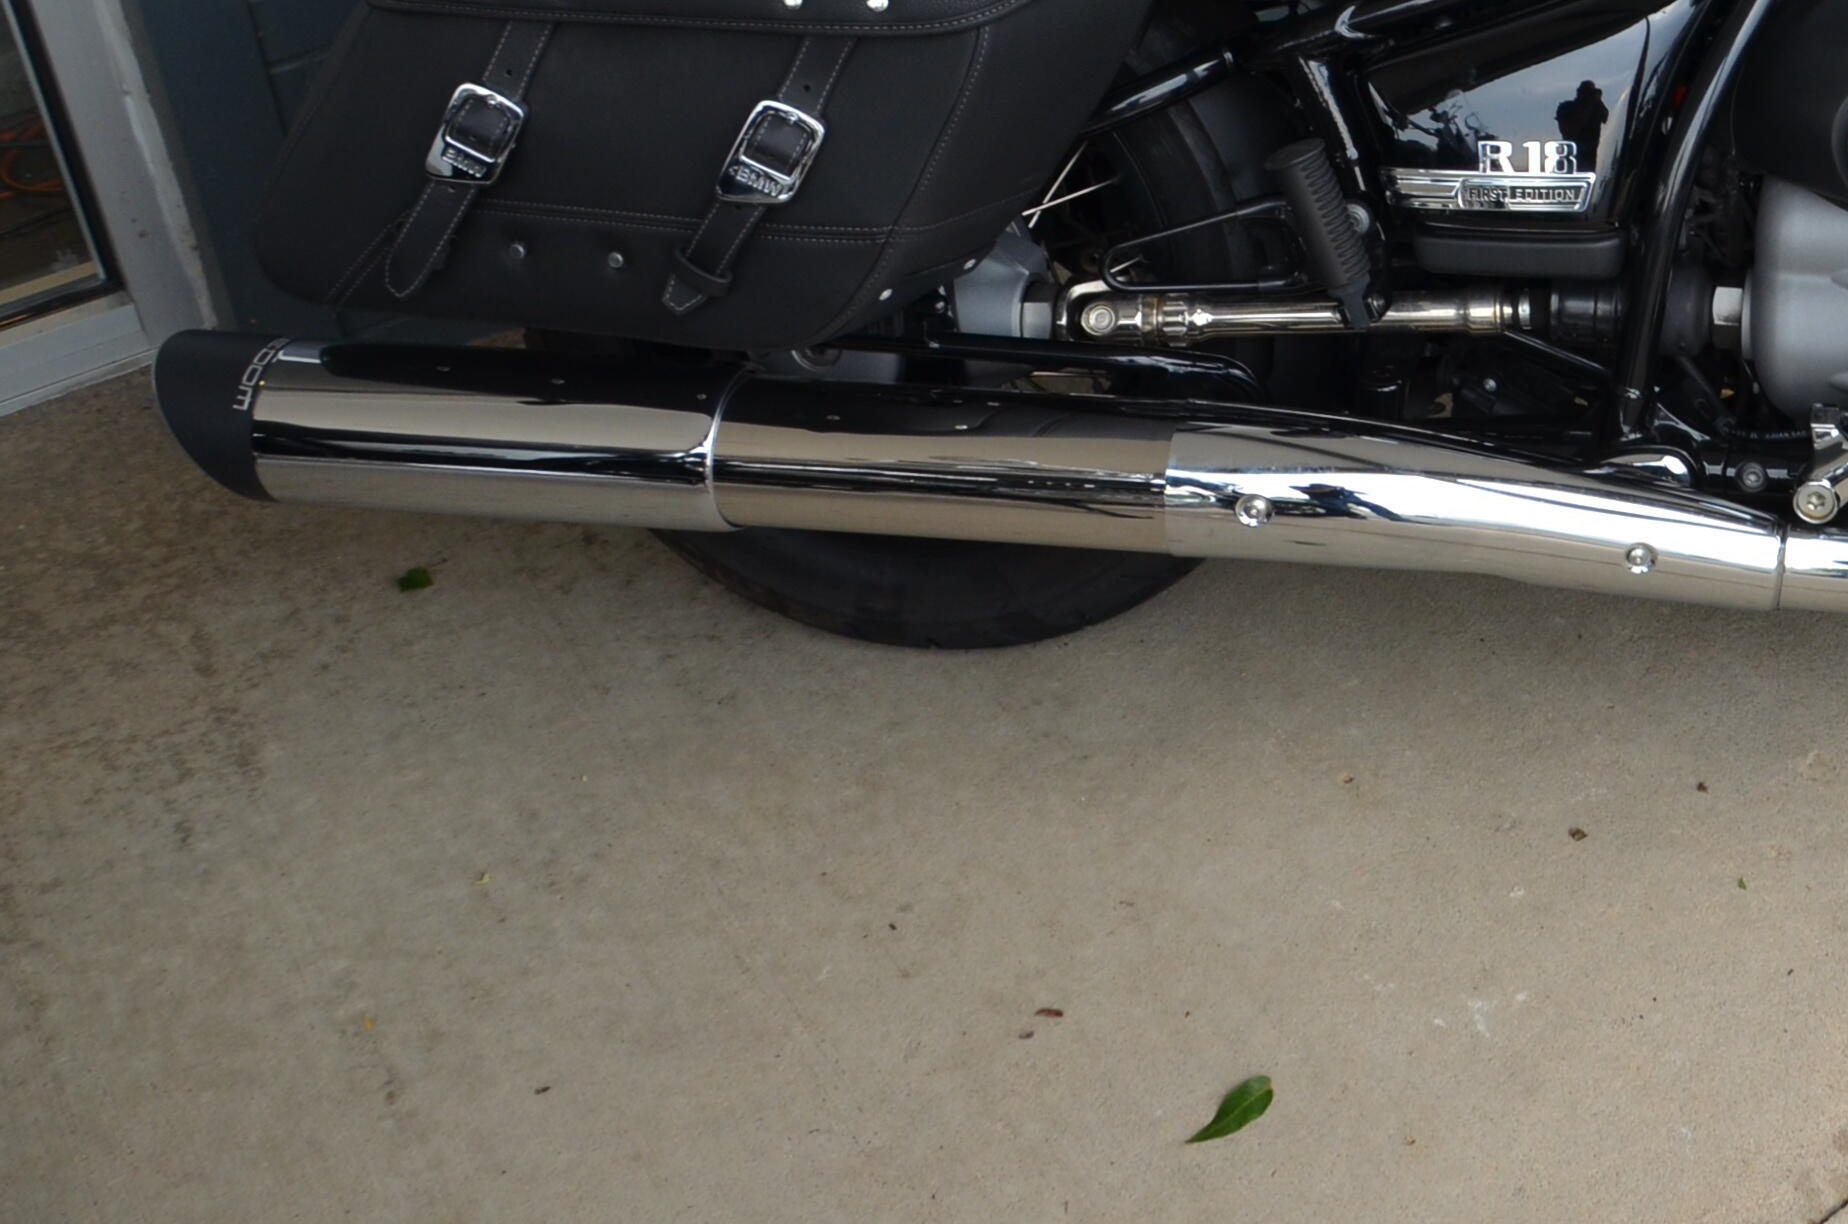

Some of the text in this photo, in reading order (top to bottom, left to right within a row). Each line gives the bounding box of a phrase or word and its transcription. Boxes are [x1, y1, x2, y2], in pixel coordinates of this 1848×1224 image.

[442, 147, 487, 178] BMW
[1478, 141, 1577, 174] R 18
[735, 166, 783, 197] BMW
[1468, 187, 1576, 202] FIRST EDITION
